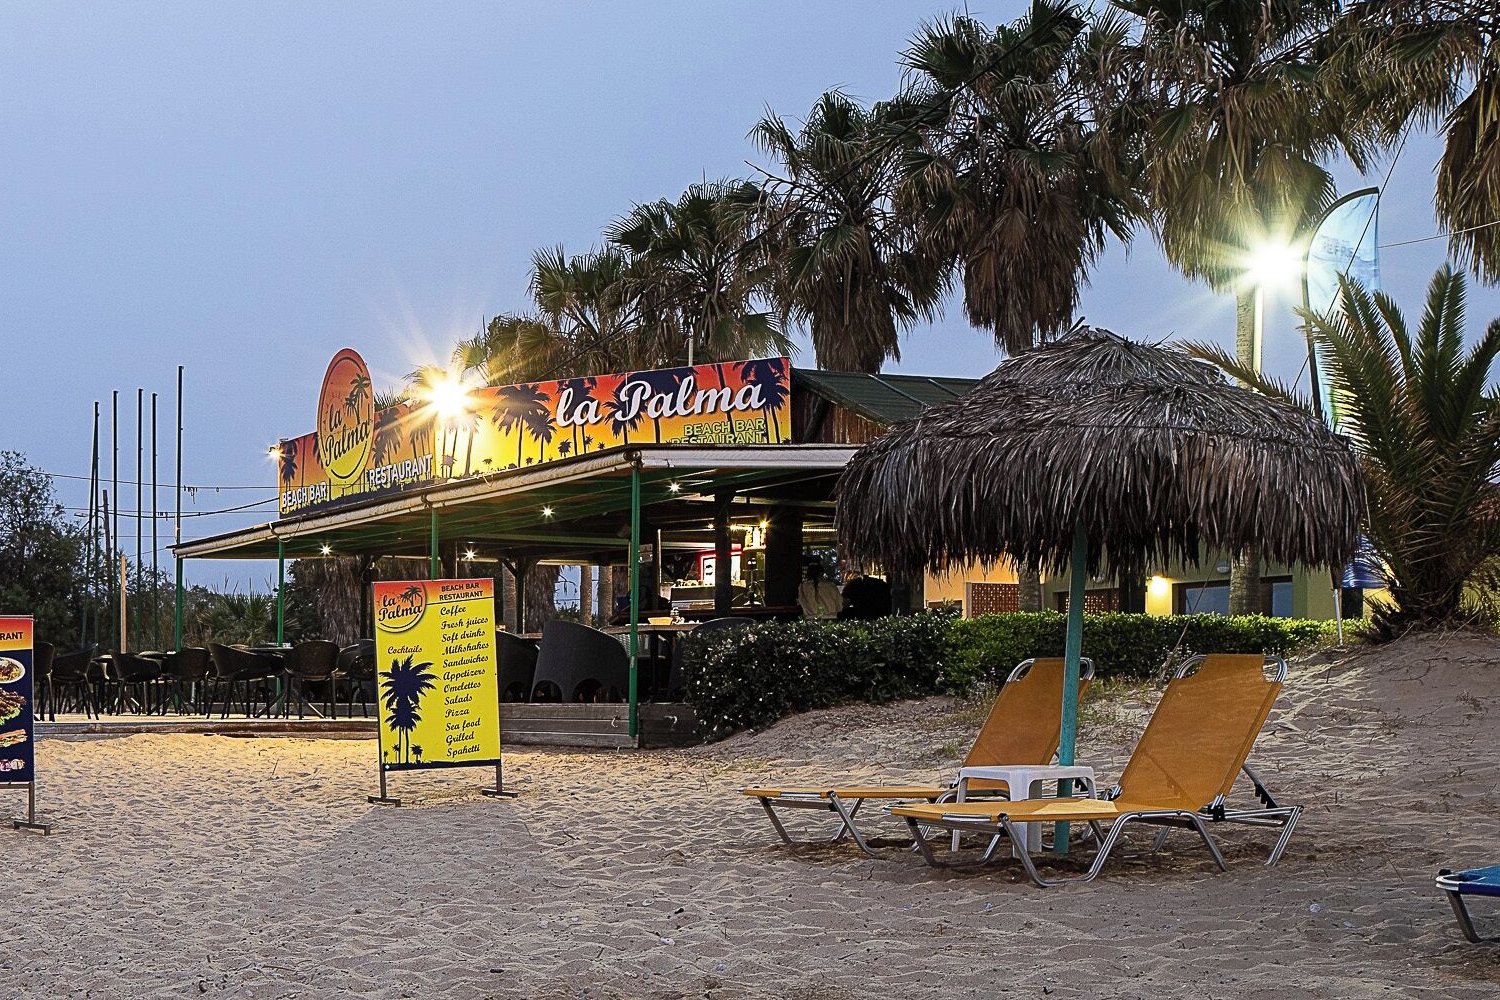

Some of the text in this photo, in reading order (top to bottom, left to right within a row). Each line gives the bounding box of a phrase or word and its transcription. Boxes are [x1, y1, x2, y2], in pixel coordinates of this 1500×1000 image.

[555, 376, 766, 427] la Palma
[329, 404, 342, 432] la
[684, 418, 765, 436] BEACH BAR
[325, 420, 370, 467] Palma
[282, 454, 433, 508] BEACH BAR RESTAURANT
[441, 582, 480, 593] BEACH BAR
[383, 594, 397, 607] la
[439, 590, 484, 601] RESTAURANT
[378, 604, 423, 622] Palma
[440, 605, 466, 616] Coffee
[441, 617, 488, 630] Fresh juices
[442, 629, 486, 643] Soft drinks
[387, 645, 423, 655] Cocktails
[442, 641, 489, 655] Milkshakes
[443, 654, 489, 668] Sandwiches
[443, 669, 486, 682] Appetizers
[443, 682, 481, 693] Omelettes
[444, 694, 473, 705] Salads
[445, 708, 469, 718] Pizza
[445, 717, 481, 731] Sea food
[445, 731, 474, 746] Grilled
[446, 744, 480, 758] Spahetti
